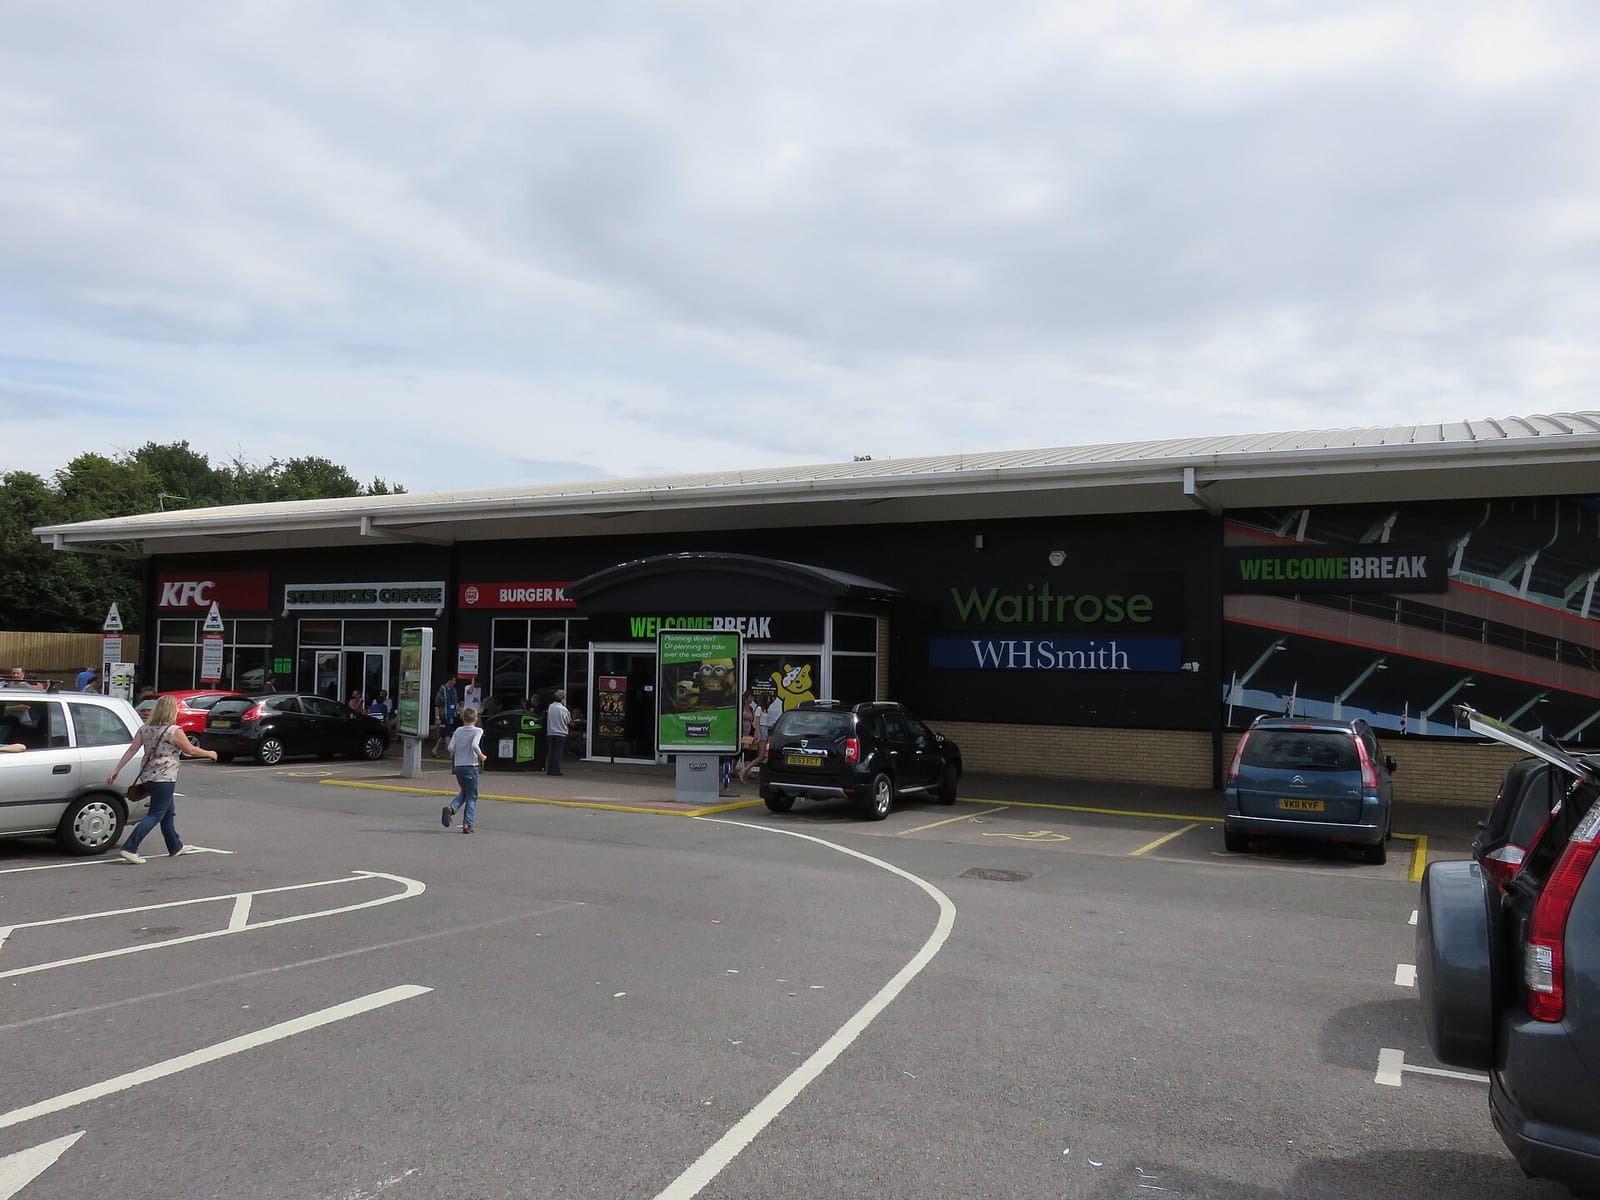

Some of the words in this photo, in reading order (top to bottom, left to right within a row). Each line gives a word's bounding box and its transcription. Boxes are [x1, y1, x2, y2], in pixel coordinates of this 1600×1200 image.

[1240, 556, 1427, 580] WELCOMEBREAK
[159, 581, 213, 606] KFC
[378, 587, 442, 603] COFFEE
[499, 588, 553, 602] BURGER
[951, 581, 1153, 623] Waitrose
[674, 643, 701, 651] planning
[971, 640, 1132, 670] WHSmith
[1283, 799, 1300, 809] VK11
[1301, 799, 1319, 809] KYF
